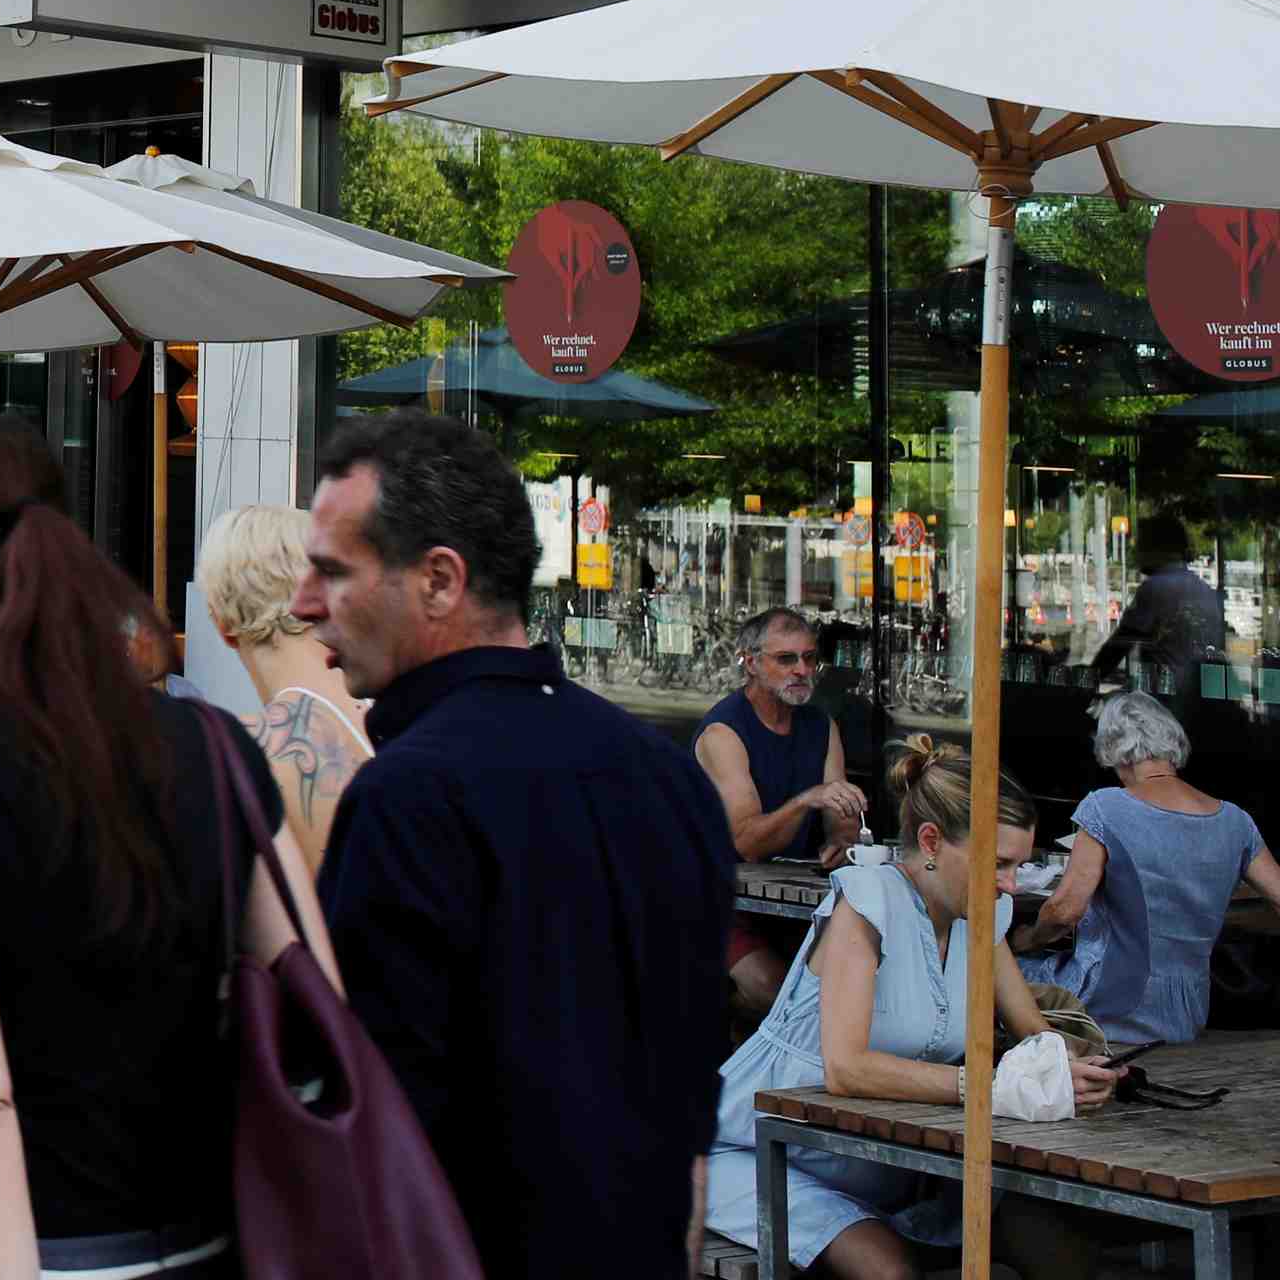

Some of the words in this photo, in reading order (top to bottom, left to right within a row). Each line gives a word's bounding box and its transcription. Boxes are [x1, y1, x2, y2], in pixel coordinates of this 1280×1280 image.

[318, 4, 380, 35] Globus
[1205, 322, 1231, 335] Wer
[543, 334, 560, 345] Wer
[1220, 335, 1252, 350] kauft
[1255, 335, 1272, 350] im
[551, 345, 573, 358] kauft
[575, 345, 588, 358] im
[555, 365, 583, 373] GLOBUS
[1225, 359, 1267, 368] GLOBUS
